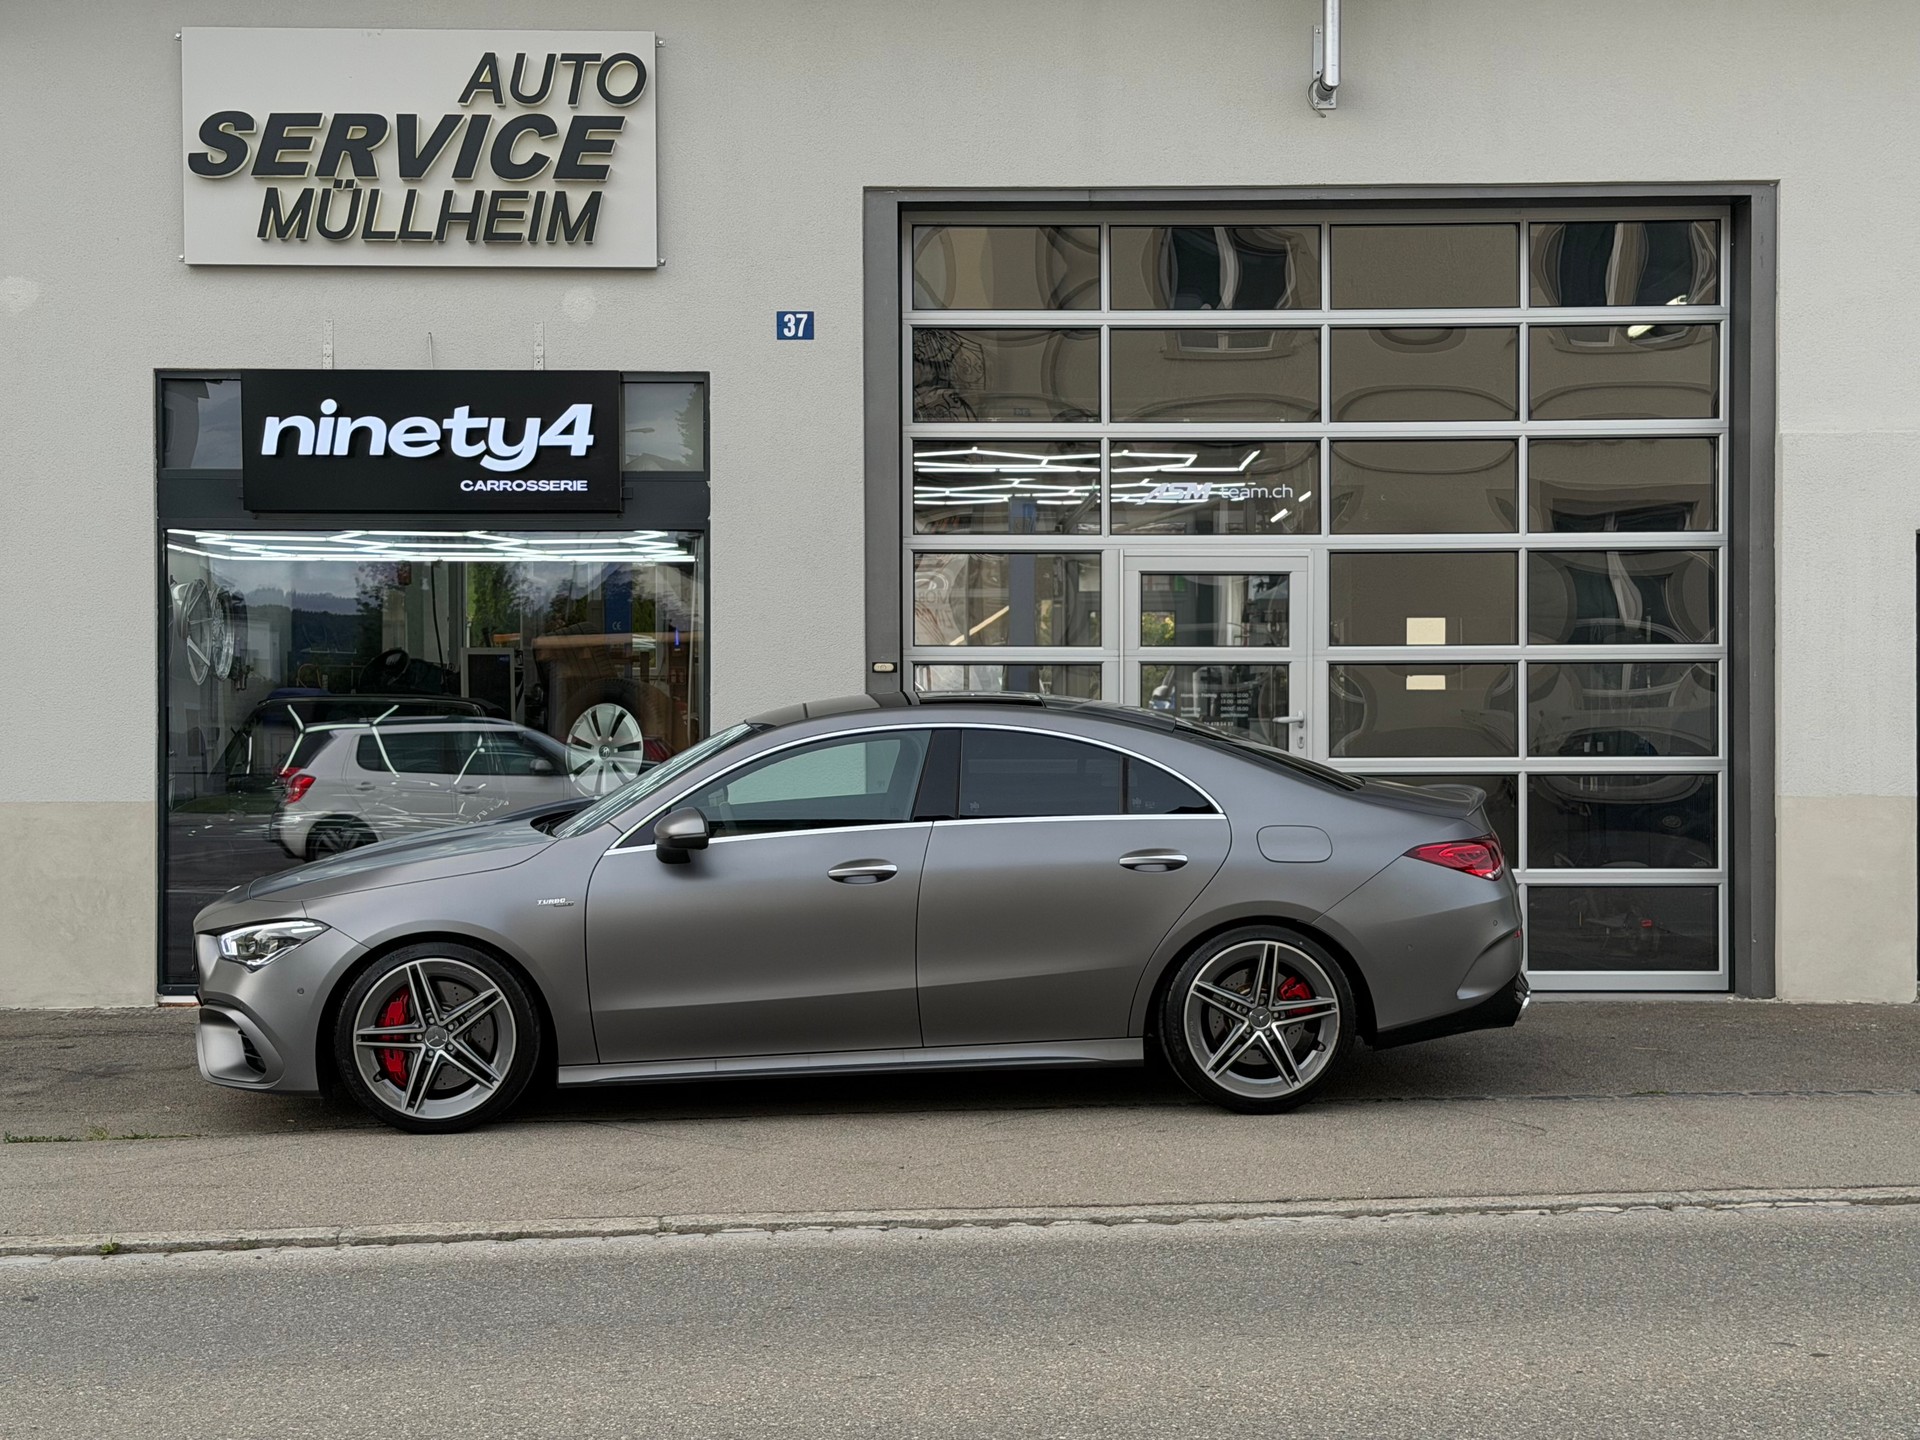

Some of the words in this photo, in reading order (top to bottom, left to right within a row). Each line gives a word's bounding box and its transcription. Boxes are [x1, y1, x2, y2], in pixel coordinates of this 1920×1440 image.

[458, 52, 647, 106] AUTO
[188, 111, 626, 181] SERVICE
[257, 178, 605, 244] MÜLLHEIM
[784, 314, 808, 337] 37
[262, 398, 594, 472] ninety4
[460, 479, 589, 493] CARROSSERIE
[1134, 482, 1214, 504] ASM
[1220, 484, 1293, 499] team.ch
[537, 898, 566, 906] TURBO
